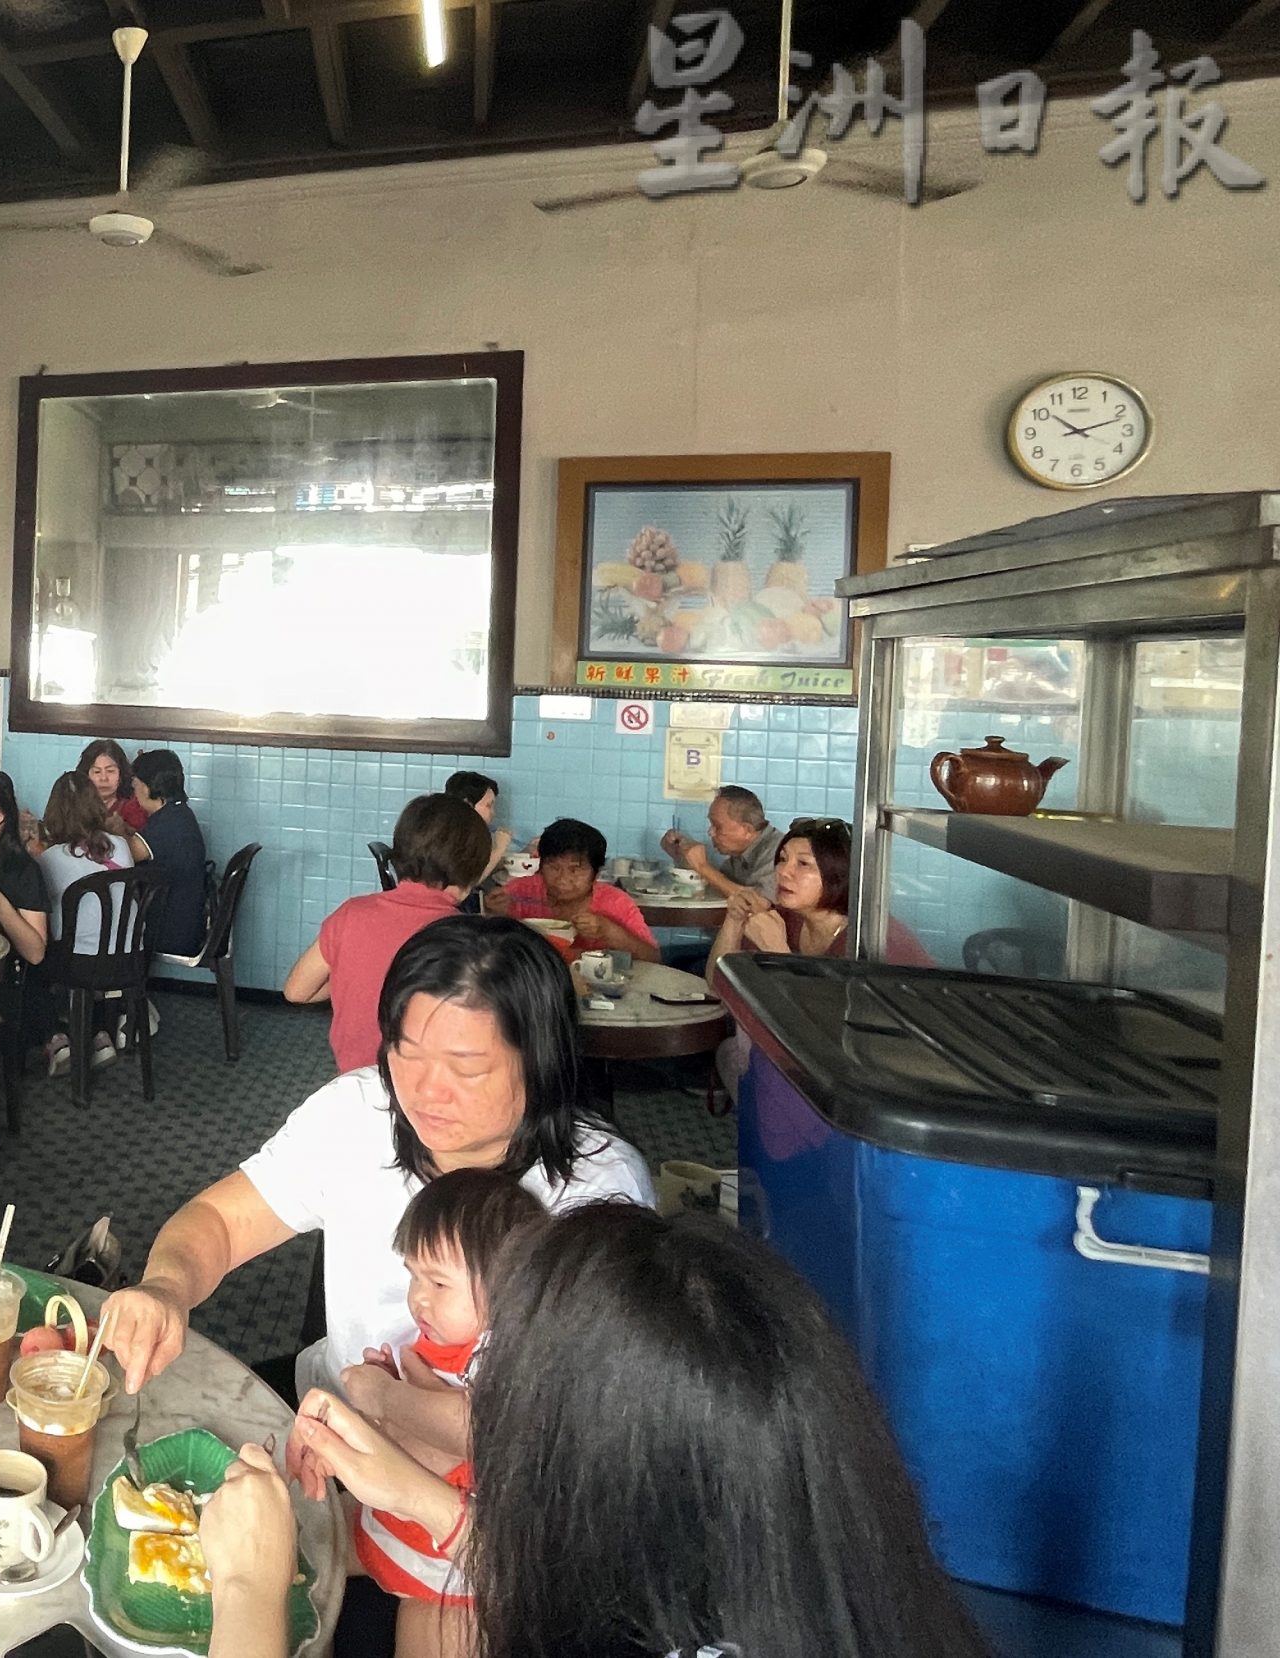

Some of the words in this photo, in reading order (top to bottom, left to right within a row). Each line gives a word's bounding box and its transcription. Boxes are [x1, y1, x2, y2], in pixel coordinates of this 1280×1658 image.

[1049, 392, 1063, 406] 11
[1071, 386, 1089, 400] 12
[1101, 390, 1108, 403] 1
[1031, 407, 1050, 421] 10
[1114, 404, 1127, 418] 2
[1024, 426, 1037, 440] 9
[1121, 423, 1134, 437] 3
[1031, 445, 1044, 459] 8
[1112, 441, 1124, 455] 4
[1048, 458, 1060, 472] 7
[1070, 463, 1083, 478] 6
[1093, 457, 1106, 471] 5
[585, 664, 690, 684] 新鮮果汁
[780, 671, 846, 691] Juice
